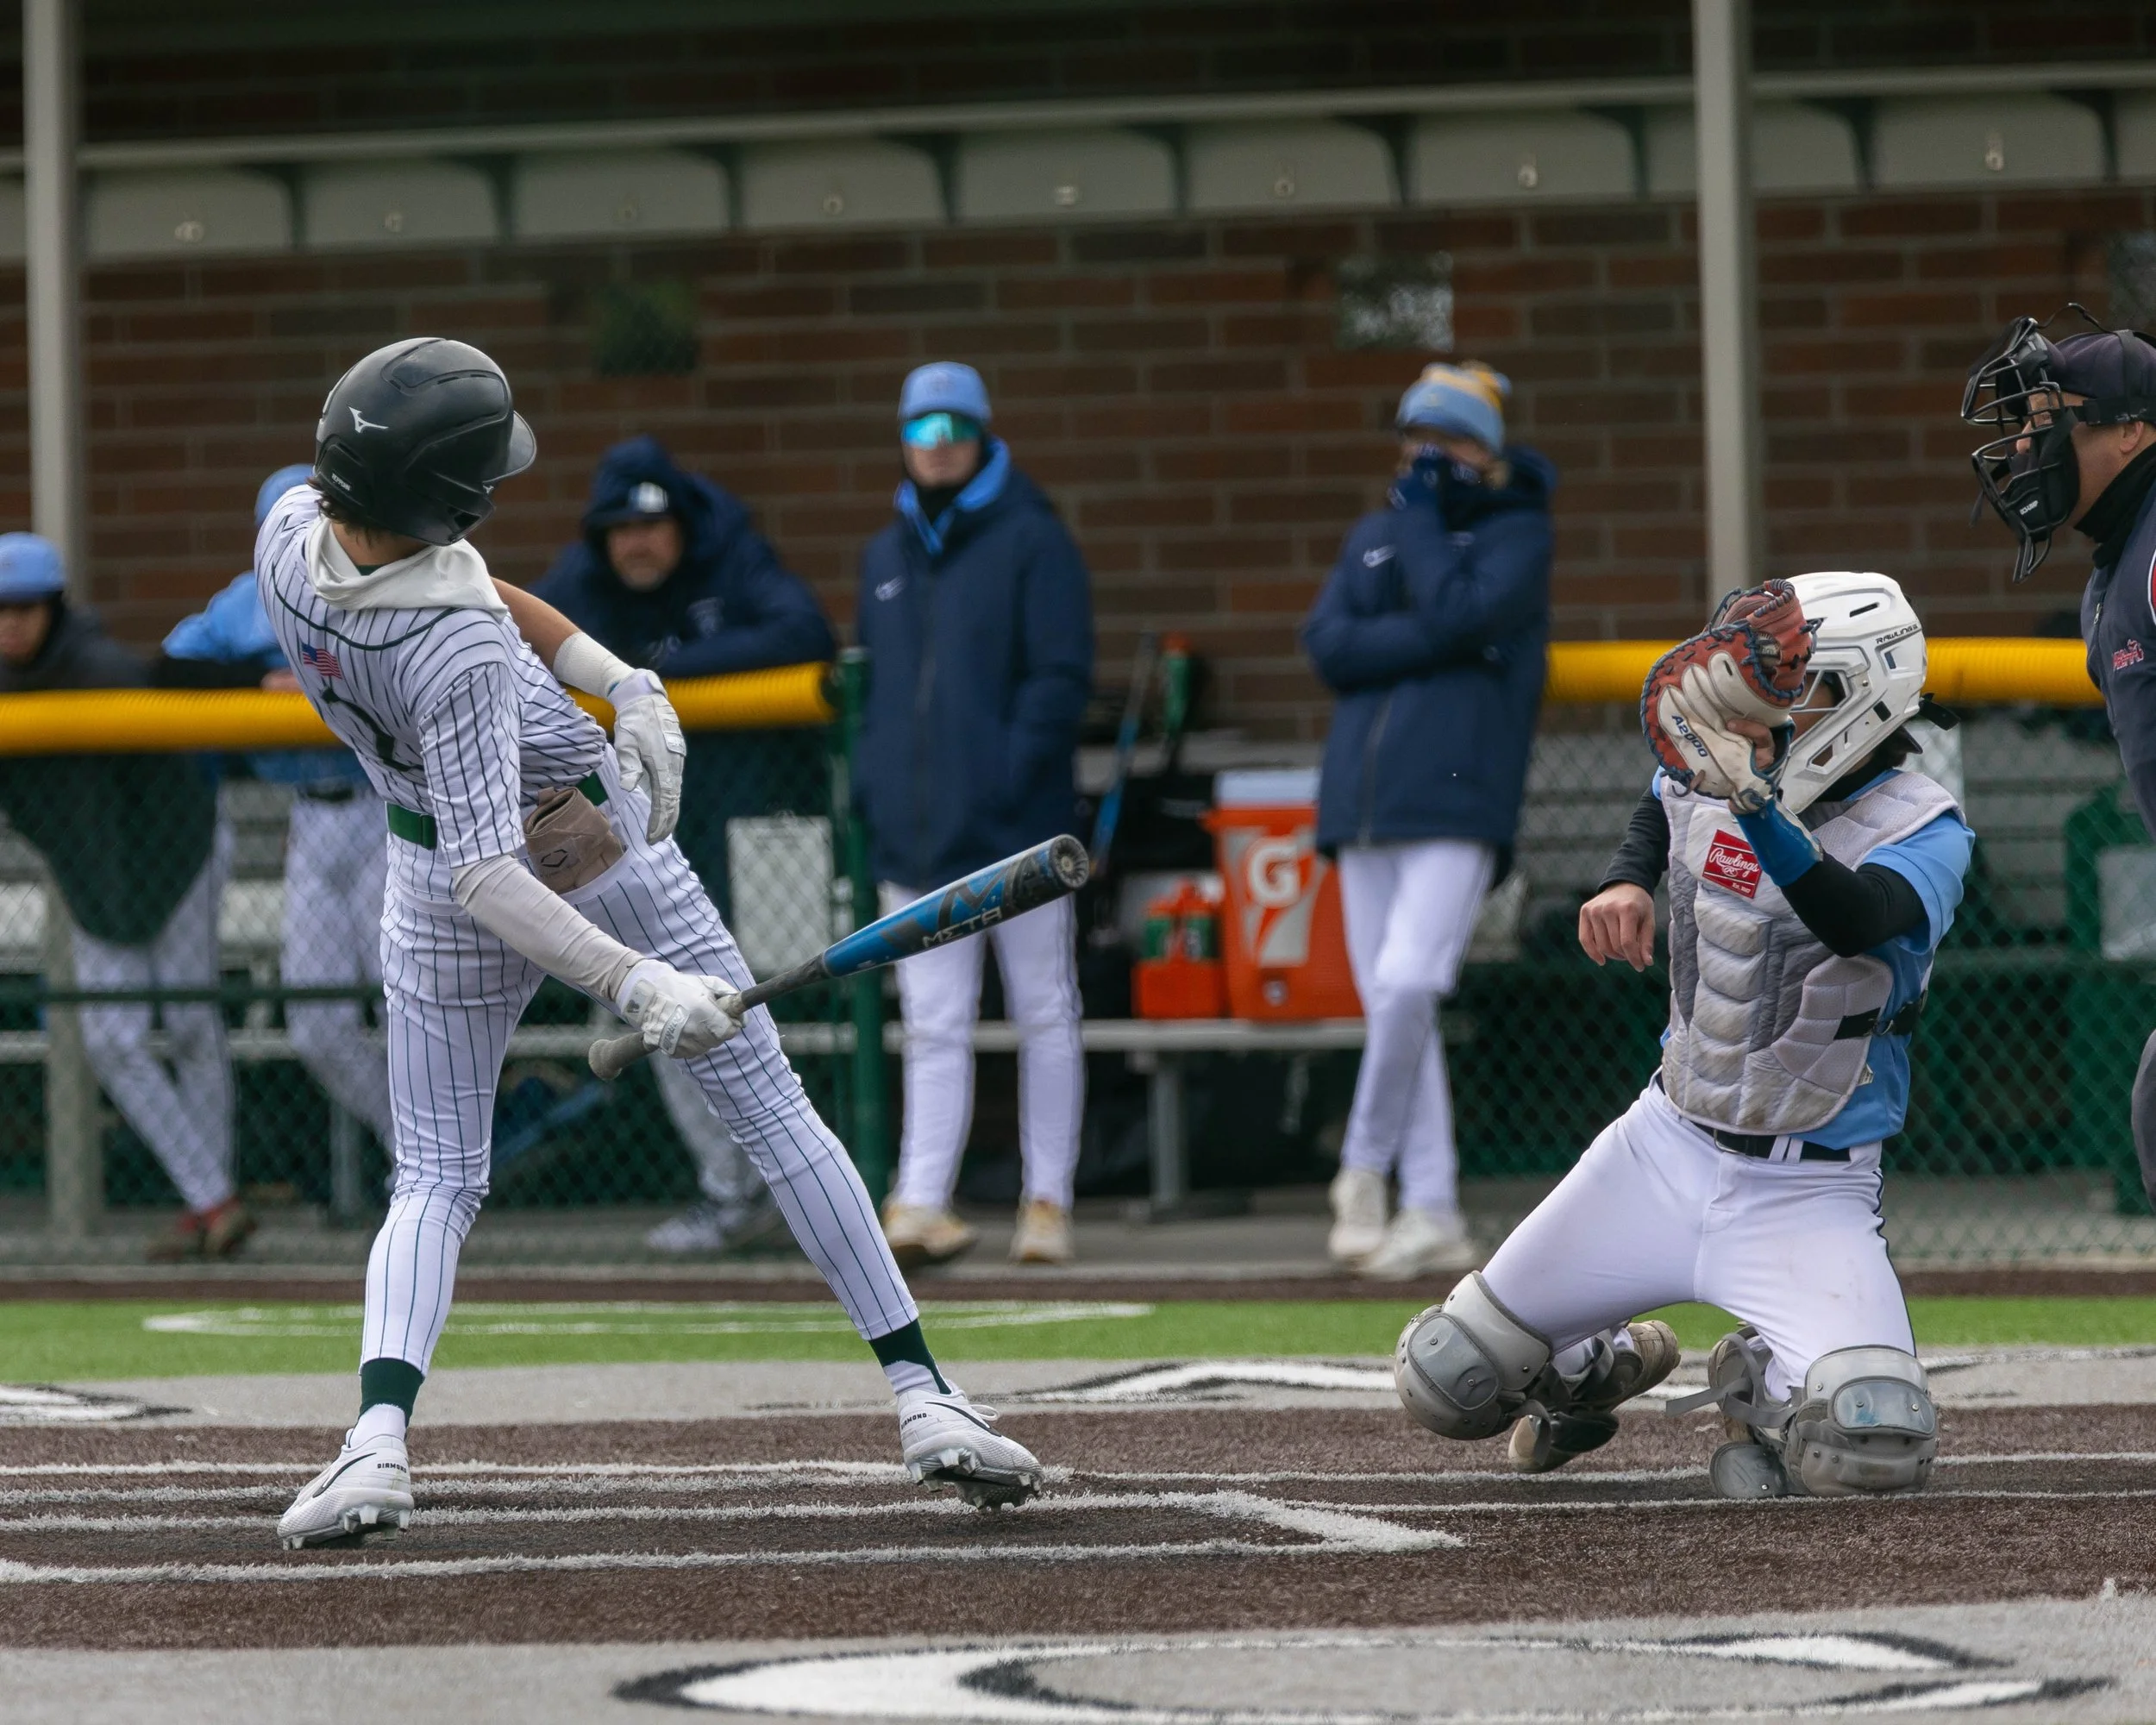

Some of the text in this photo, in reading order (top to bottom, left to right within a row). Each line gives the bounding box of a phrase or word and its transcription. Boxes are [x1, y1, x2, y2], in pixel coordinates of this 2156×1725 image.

[1671, 715, 1708, 757] A2000
[1247, 836, 1301, 908] G
[1709, 847, 1759, 877] Rawlings
[922, 906, 1004, 949] META
